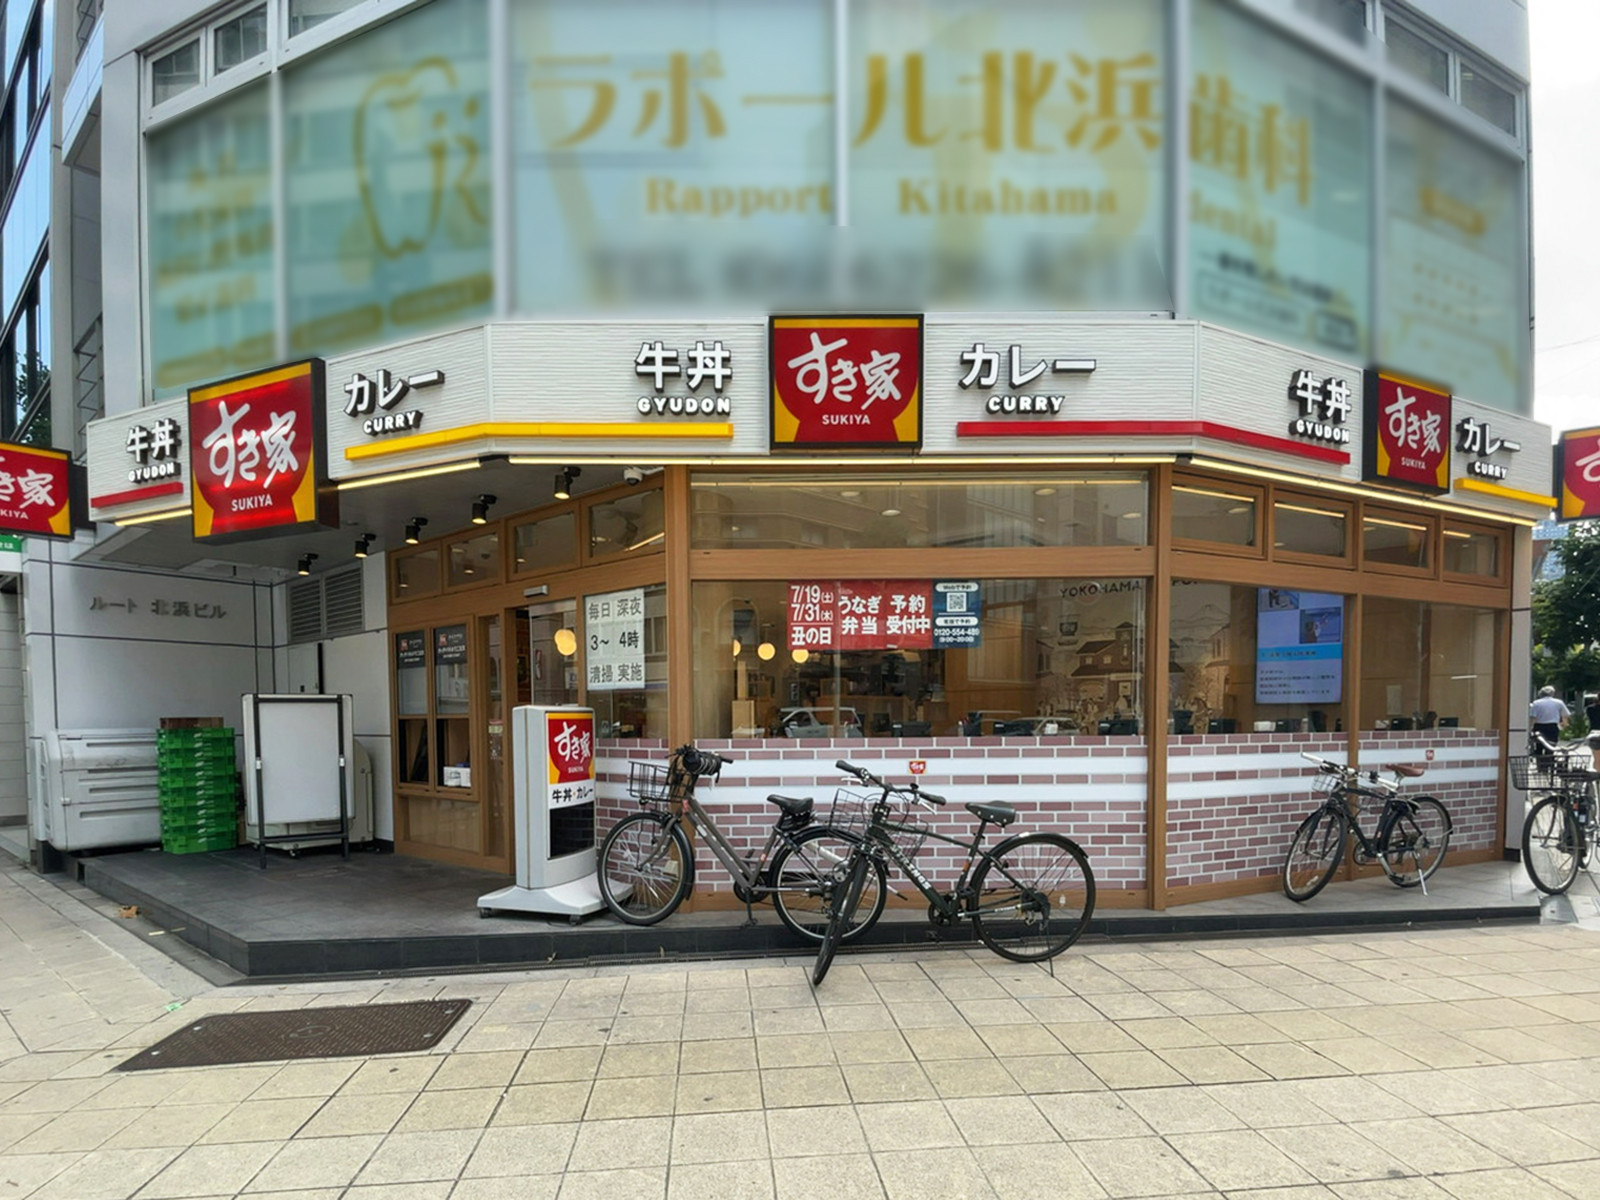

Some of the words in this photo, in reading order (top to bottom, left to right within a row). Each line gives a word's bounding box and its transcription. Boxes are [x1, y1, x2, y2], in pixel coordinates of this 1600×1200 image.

[644, 177, 834, 221] Rapport
[897, 177, 1119, 217] Kitahama
[635, 340, 732, 392] 牛丼
[787, 331, 902, 410] すき家
[957, 342, 1096, 390] カレー
[344, 370, 443, 416] カレー
[1292, 370, 1351, 423] 牛丼
[636, 396, 731, 416] GYUDON
[985, 395, 1065, 414] CURRY
[363, 411, 420, 434] CURRY
[821, 413, 871, 426] SUKIYA
[1384, 387, 1441, 457] すき家
[127, 418, 179, 463] 牛丼
[1292, 419, 1350, 443] GYUDON
[1459, 417, 1521, 456] カレー
[202, 400, 299, 489] すき家
[128, 462, 178, 482] GYUDON
[1401, 456, 1426, 470] SUKIYA
[1470, 461, 1508, 480] CURRY
[231, 494, 273, 511] SUKIYA
[791, 585, 834, 603] 7/19(土)
[838, 595, 882, 614] うなぎ
[890, 594, 926, 613] 予約
[589, 603, 611, 620] 毎日
[617, 597, 642, 616] 深夜
[791, 603, 833, 621] 7/31(木)
[791, 626, 832, 646] 丑の日
[841, 615, 877, 635] 弁当
[886, 615, 930, 634] 受付中
[619, 630, 640, 649] 4時
[590, 665, 613, 683] 清掃
[618, 662, 643, 682] 実施
[554, 721, 591, 763] すき家
